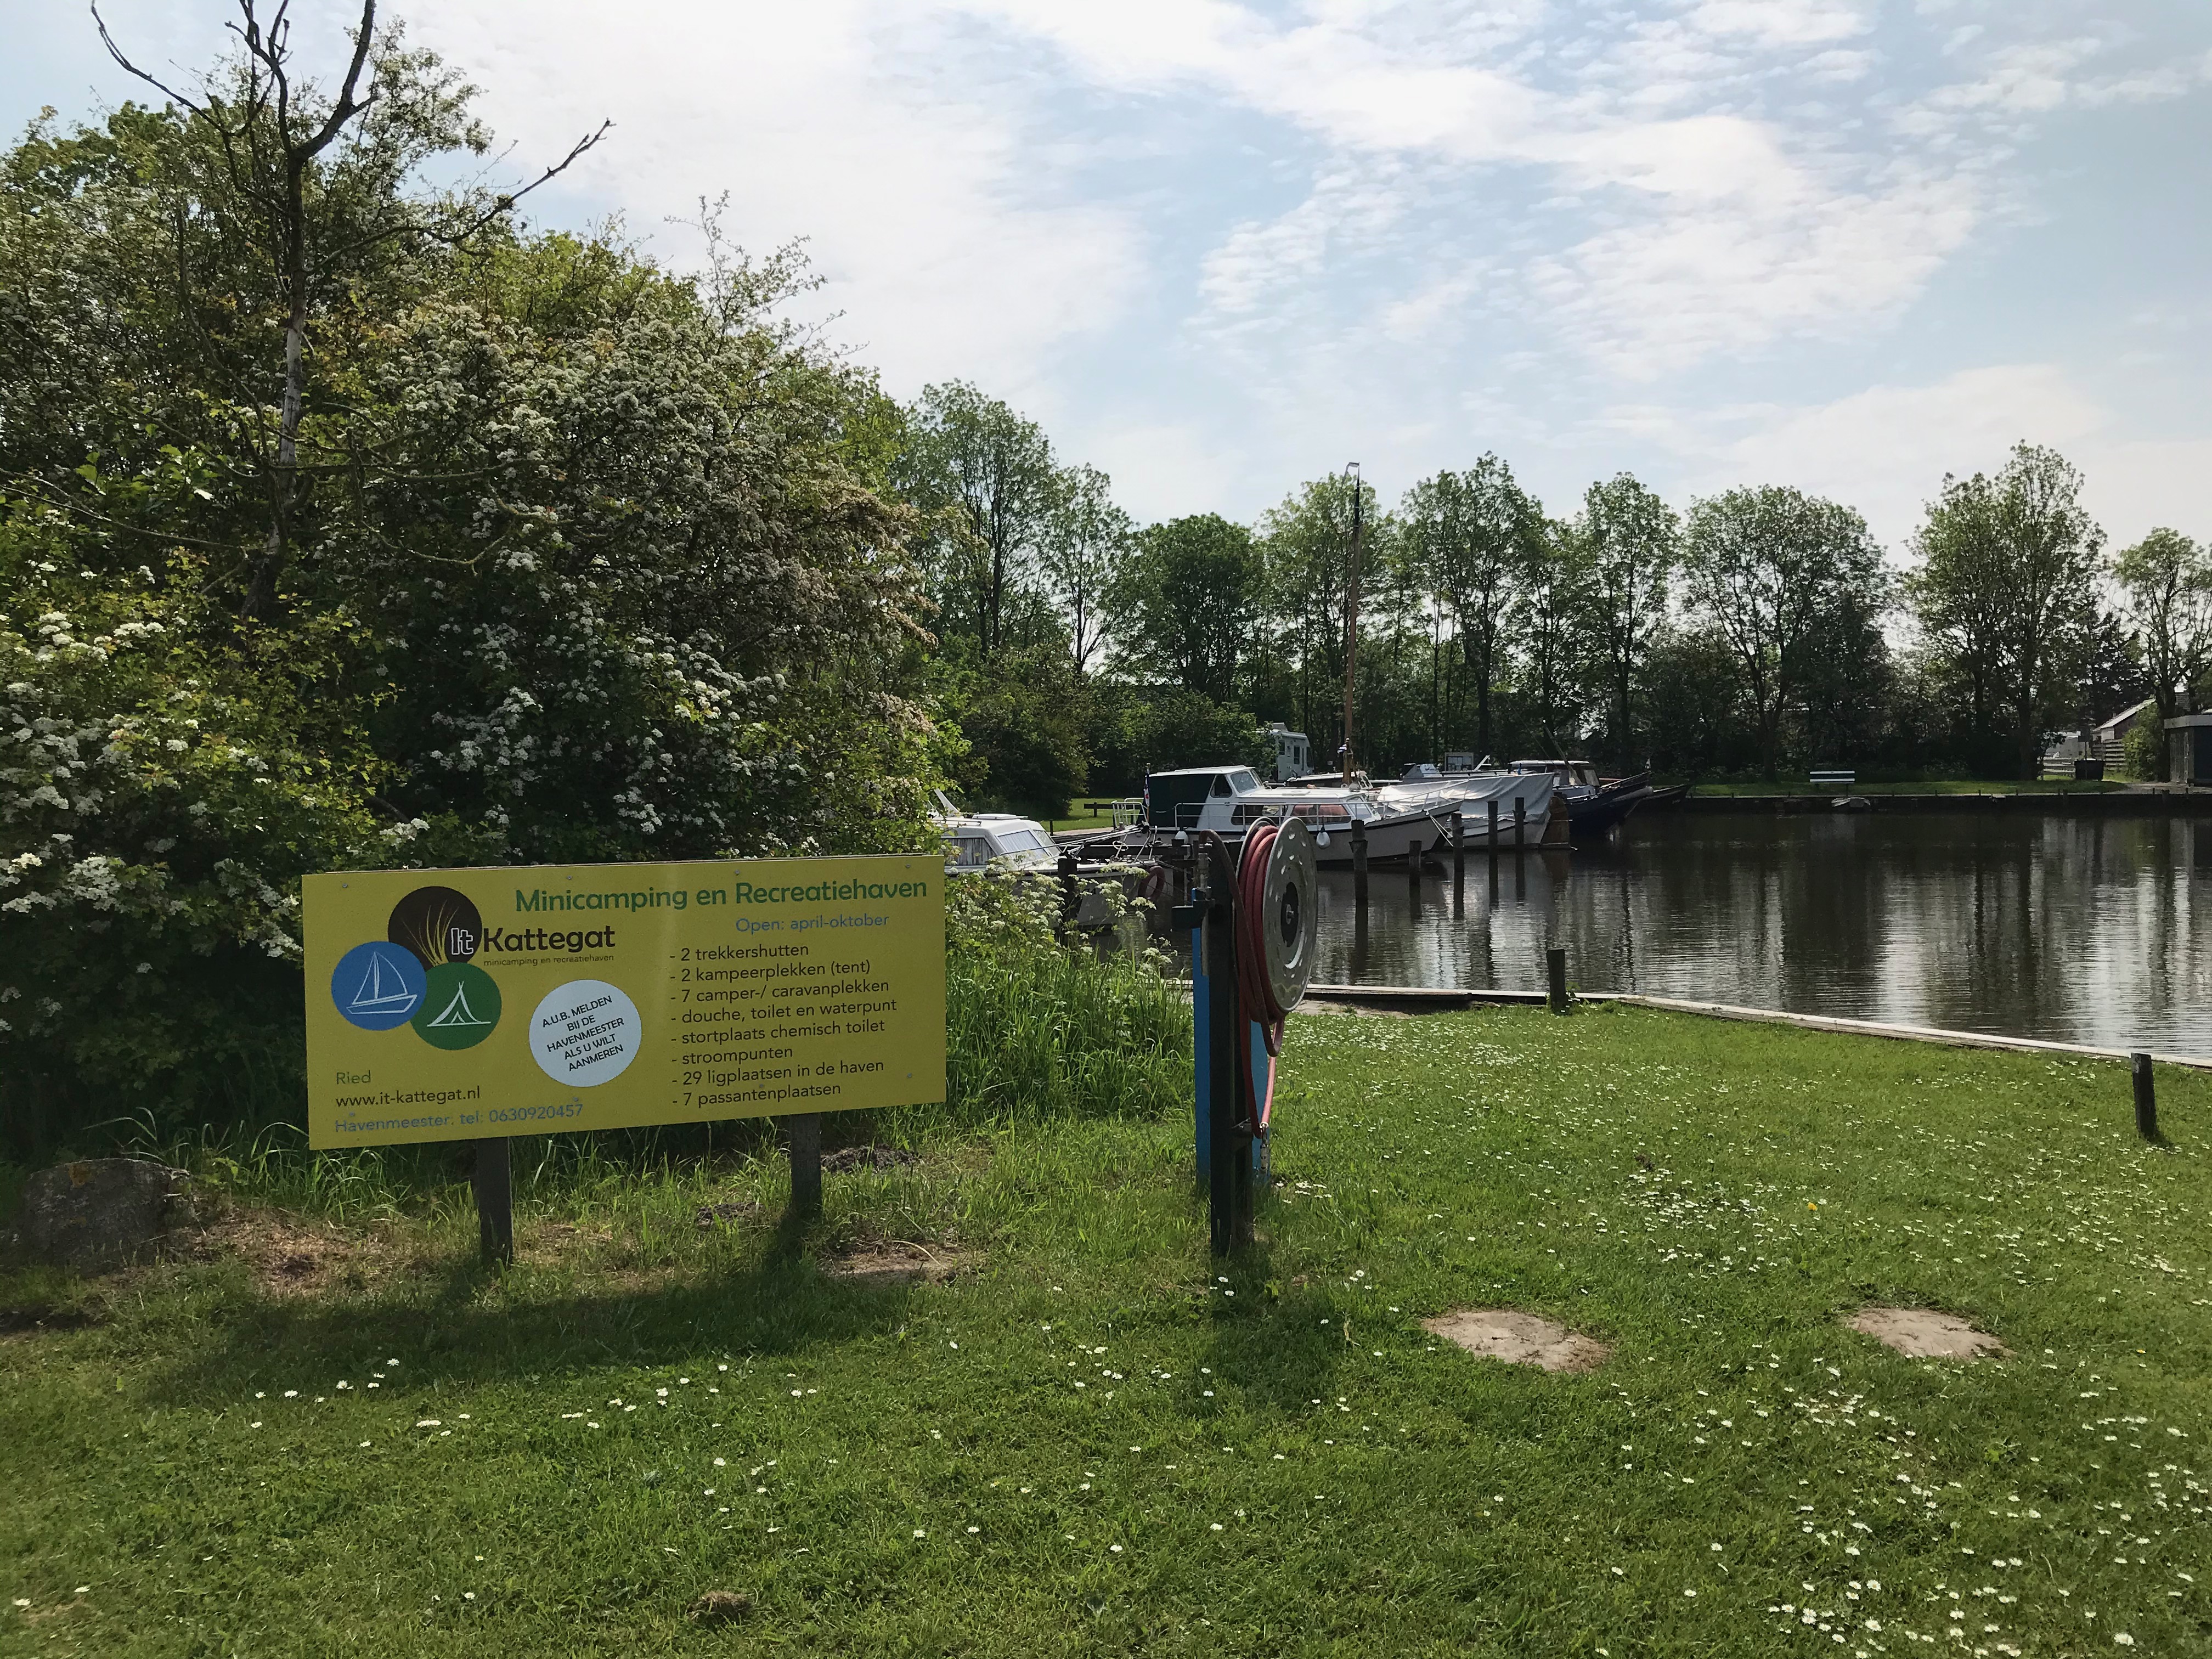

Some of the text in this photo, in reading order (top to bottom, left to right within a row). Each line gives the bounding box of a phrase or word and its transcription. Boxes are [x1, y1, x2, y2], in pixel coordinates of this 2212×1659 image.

[516, 879, 927, 912] Minicamping en Recreatiehaven
[736, 913, 889, 935] Open: april-oktober
[450, 926, 616, 956] It Kattegat
[681, 947, 690, 961] 2
[695, 944, 809, 961] trekkershutten
[484, 957, 538, 966] minicamping
[554, 954, 614, 963] recreatiehaven
[681, 968, 691, 982] 2
[696, 962, 825, 983] kampeerplekken
[831, 959, 870, 976] (tent)
[681, 989, 691, 1003] 7
[772, 979, 889, 998] caravanplekken
[542, 995, 612, 1028] A.U.B. MELDEN
[567, 1015, 596, 1031] BIJ DE
[681, 1007, 745, 1023] douche,
[751, 1004, 792, 1019] toilet
[796, 1006, 814, 1017] en
[819, 999, 897, 1015] waterpunt
[546, 1018, 624, 1052] HAVENMEESTER
[682, 1027, 765, 1045] stortplaats
[771, 1020, 840, 1039] chemisch
[846, 1018, 885, 1033] toilet
[565, 1047, 582, 1060] ALS
[592, 1034, 616, 1048] WILT
[569, 1044, 624, 1071] AANMEREN
[682, 1047, 793, 1065] stroompunten
[336, 1070, 371, 1085] Ried
[682, 1071, 702, 1085] 29
[708, 1068, 792, 1087] ligplaatsen
[798, 1064, 810, 1077] in
[816, 1062, 835, 1076] de
[840, 1060, 884, 1074] haven
[335, 1085, 480, 1107] www.it-kattegat.nl
[684, 1092, 692, 1106] 7
[698, 1084, 841, 1108] passantenplaatsen
[489, 1103, 583, 1122] 0630920457
